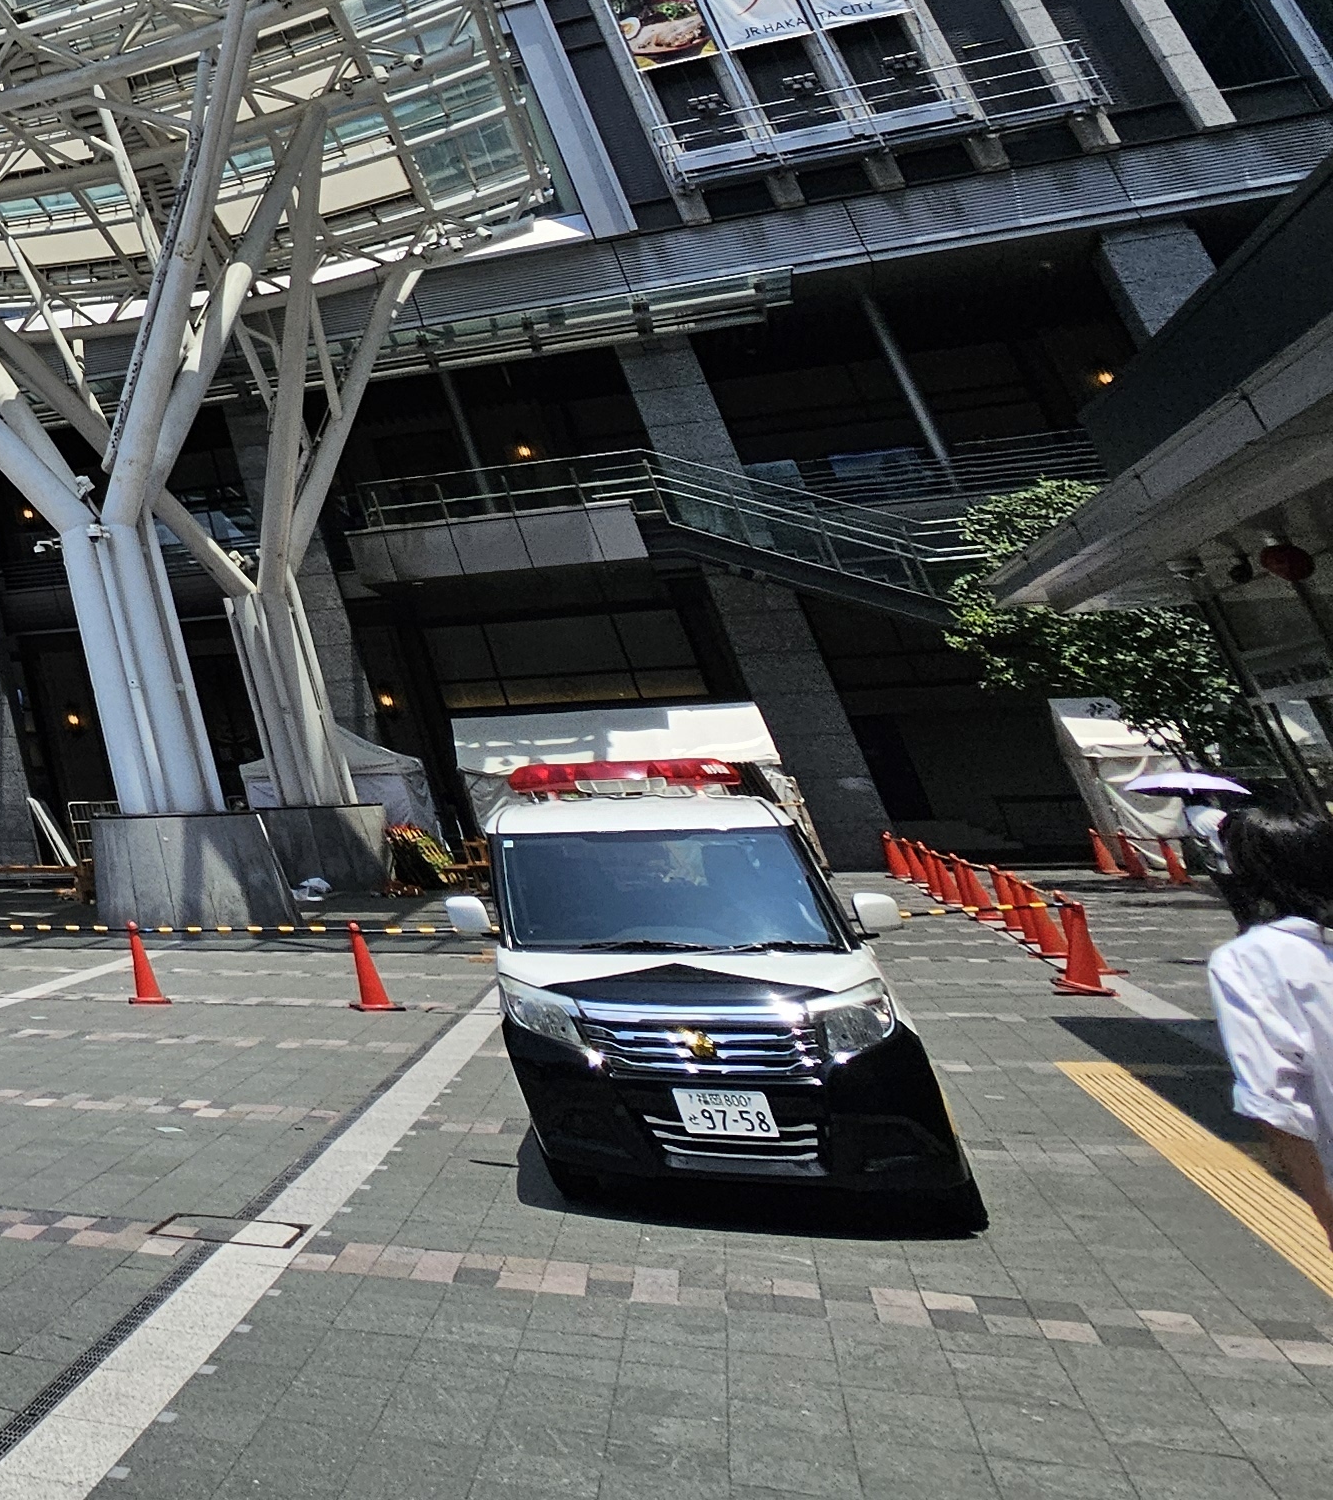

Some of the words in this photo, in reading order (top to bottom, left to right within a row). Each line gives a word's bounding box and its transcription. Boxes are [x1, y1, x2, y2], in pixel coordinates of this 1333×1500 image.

[744, 26, 763, 40] JR
[840, 1, 875, 17] CITY
[723, 1094, 749, 1107] 800
[700, 1108, 772, 1133] 97-58
